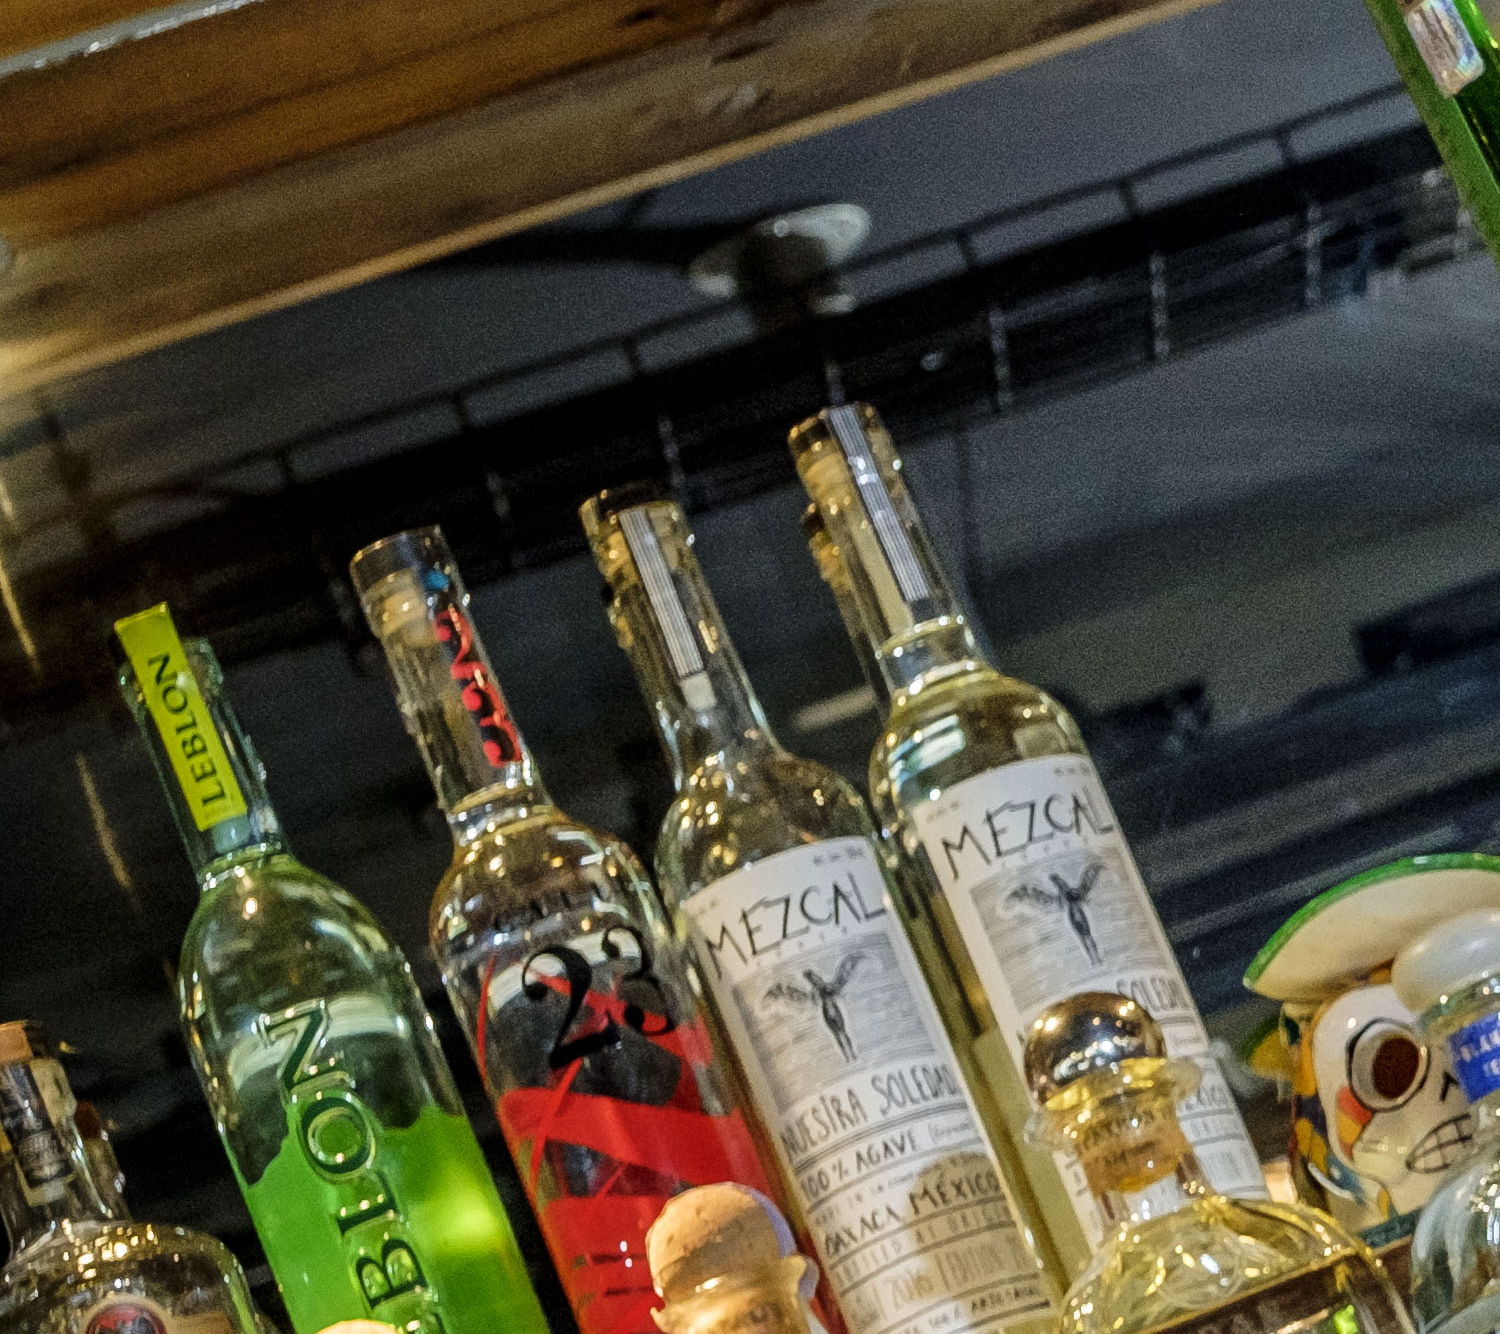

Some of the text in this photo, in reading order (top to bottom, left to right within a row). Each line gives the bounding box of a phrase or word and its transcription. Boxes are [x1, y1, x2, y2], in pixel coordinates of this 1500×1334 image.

[147, 651, 226, 807] LEBLON
[941, 783, 1114, 881] MEZCAL
[703, 870, 888, 980] MEZCAL
[855, 1133, 918, 1171] AGAVE
